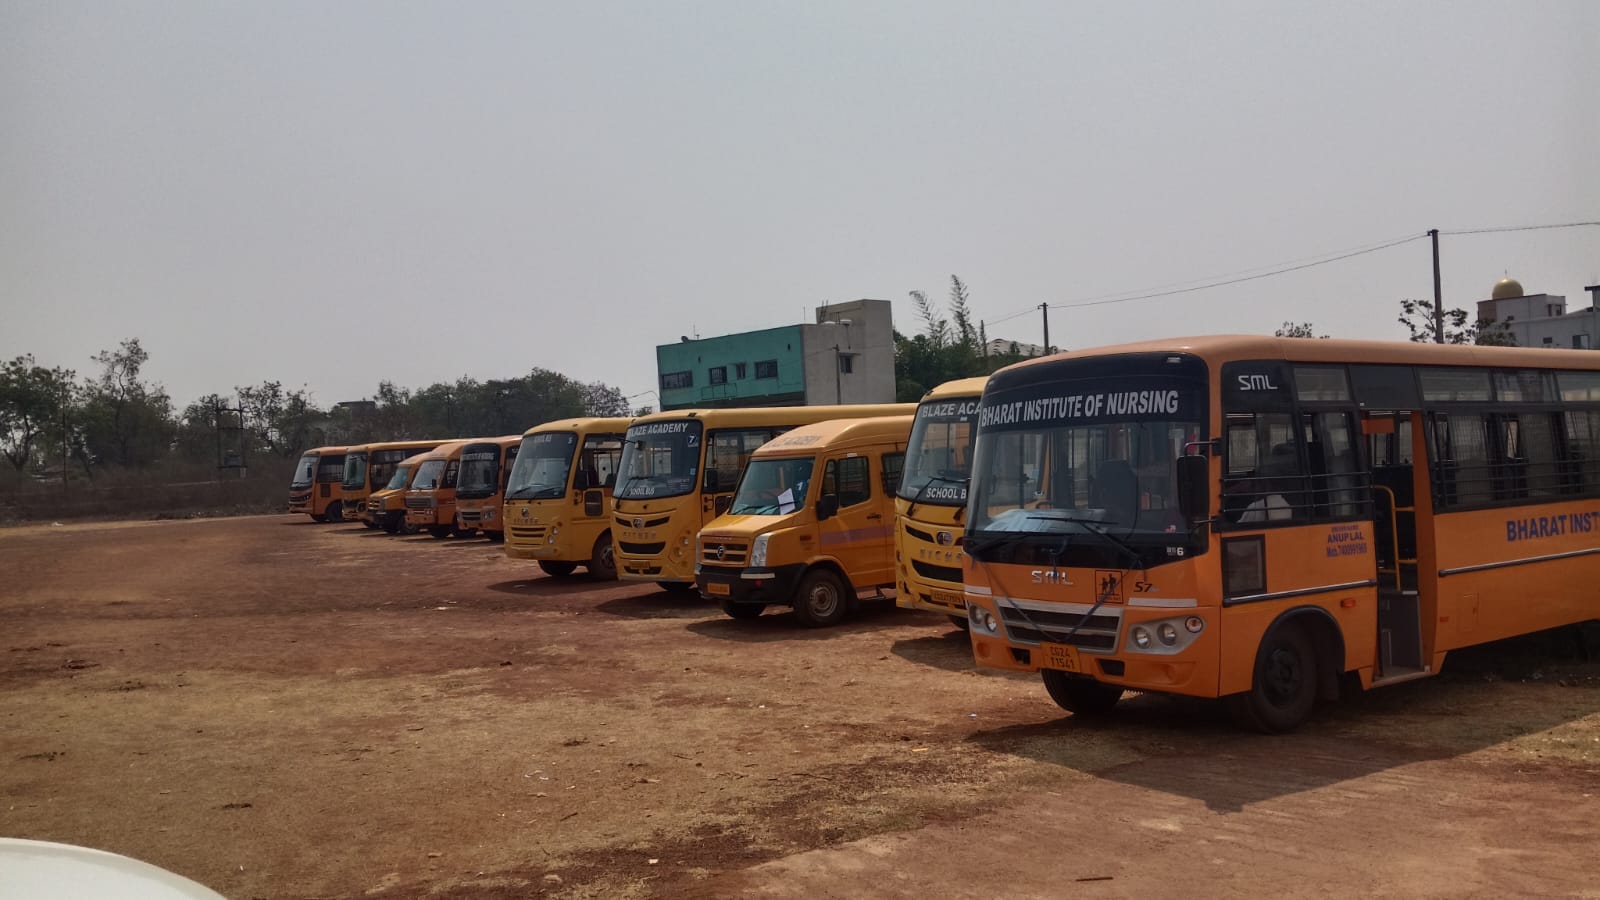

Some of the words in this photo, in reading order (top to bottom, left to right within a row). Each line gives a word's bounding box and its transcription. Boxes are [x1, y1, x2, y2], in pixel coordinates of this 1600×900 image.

[1238, 375, 1278, 390] SML
[922, 404, 955, 417] BLAZE
[981, 402, 1022, 427] BHARAT
[1023, 395, 1083, 421] INSTITUTE
[1085, 394, 1103, 417] OF
[1106, 390, 1179, 415] NURSING
[648, 423, 688, 434] ACADEMY
[688, 435, 695, 444] 7
[927, 487, 958, 498] SCHOOL
[1506, 515, 1567, 541] BHARAT
